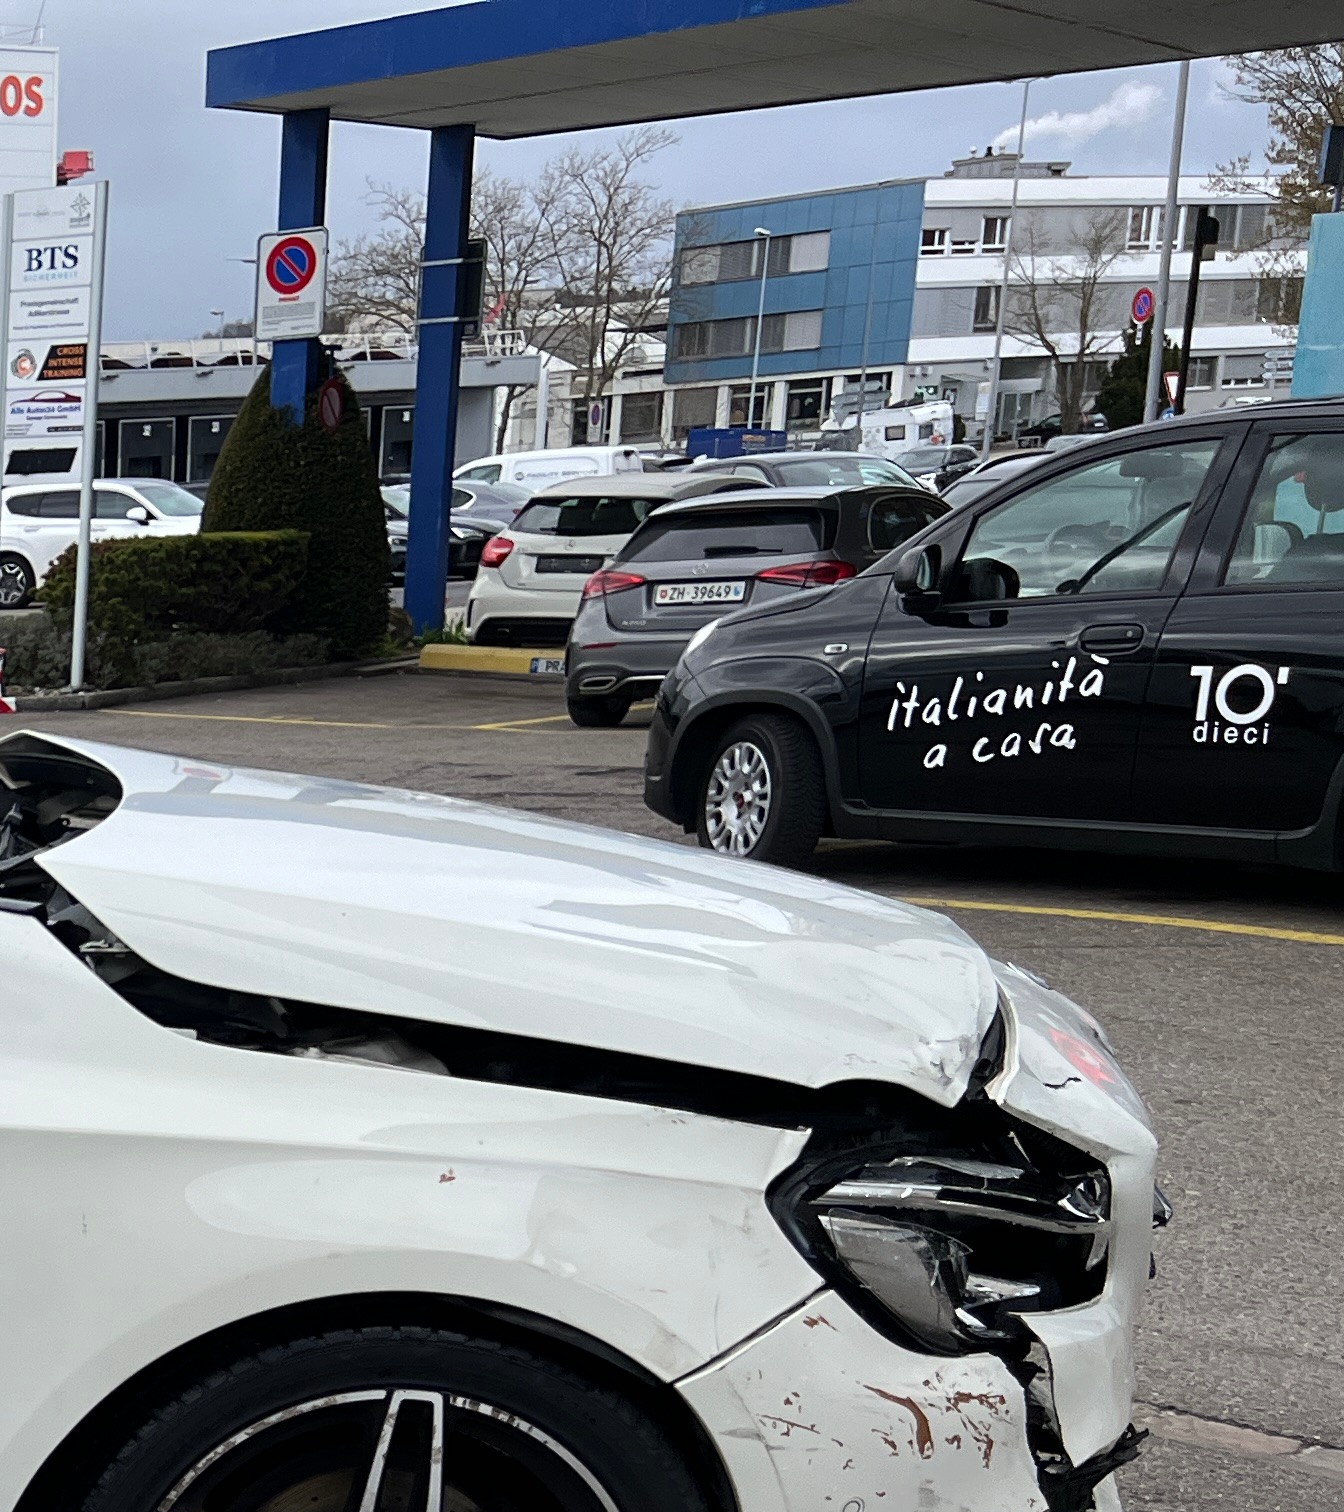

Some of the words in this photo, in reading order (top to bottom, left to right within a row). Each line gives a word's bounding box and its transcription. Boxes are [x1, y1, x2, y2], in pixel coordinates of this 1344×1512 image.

[23, 244, 79, 272] BTS
[56, 345, 85, 356] CROSS
[48, 356, 84, 367] INTENSE
[43, 367, 84, 378] TRAINING
[669, 588, 686, 600] ZH
[693, 585, 732, 598] 39649
[887, 653, 1110, 731] italianità
[1192, 721, 1270, 745] dieci
[923, 743, 947, 769] a
[972, 722, 1077, 763] casa
